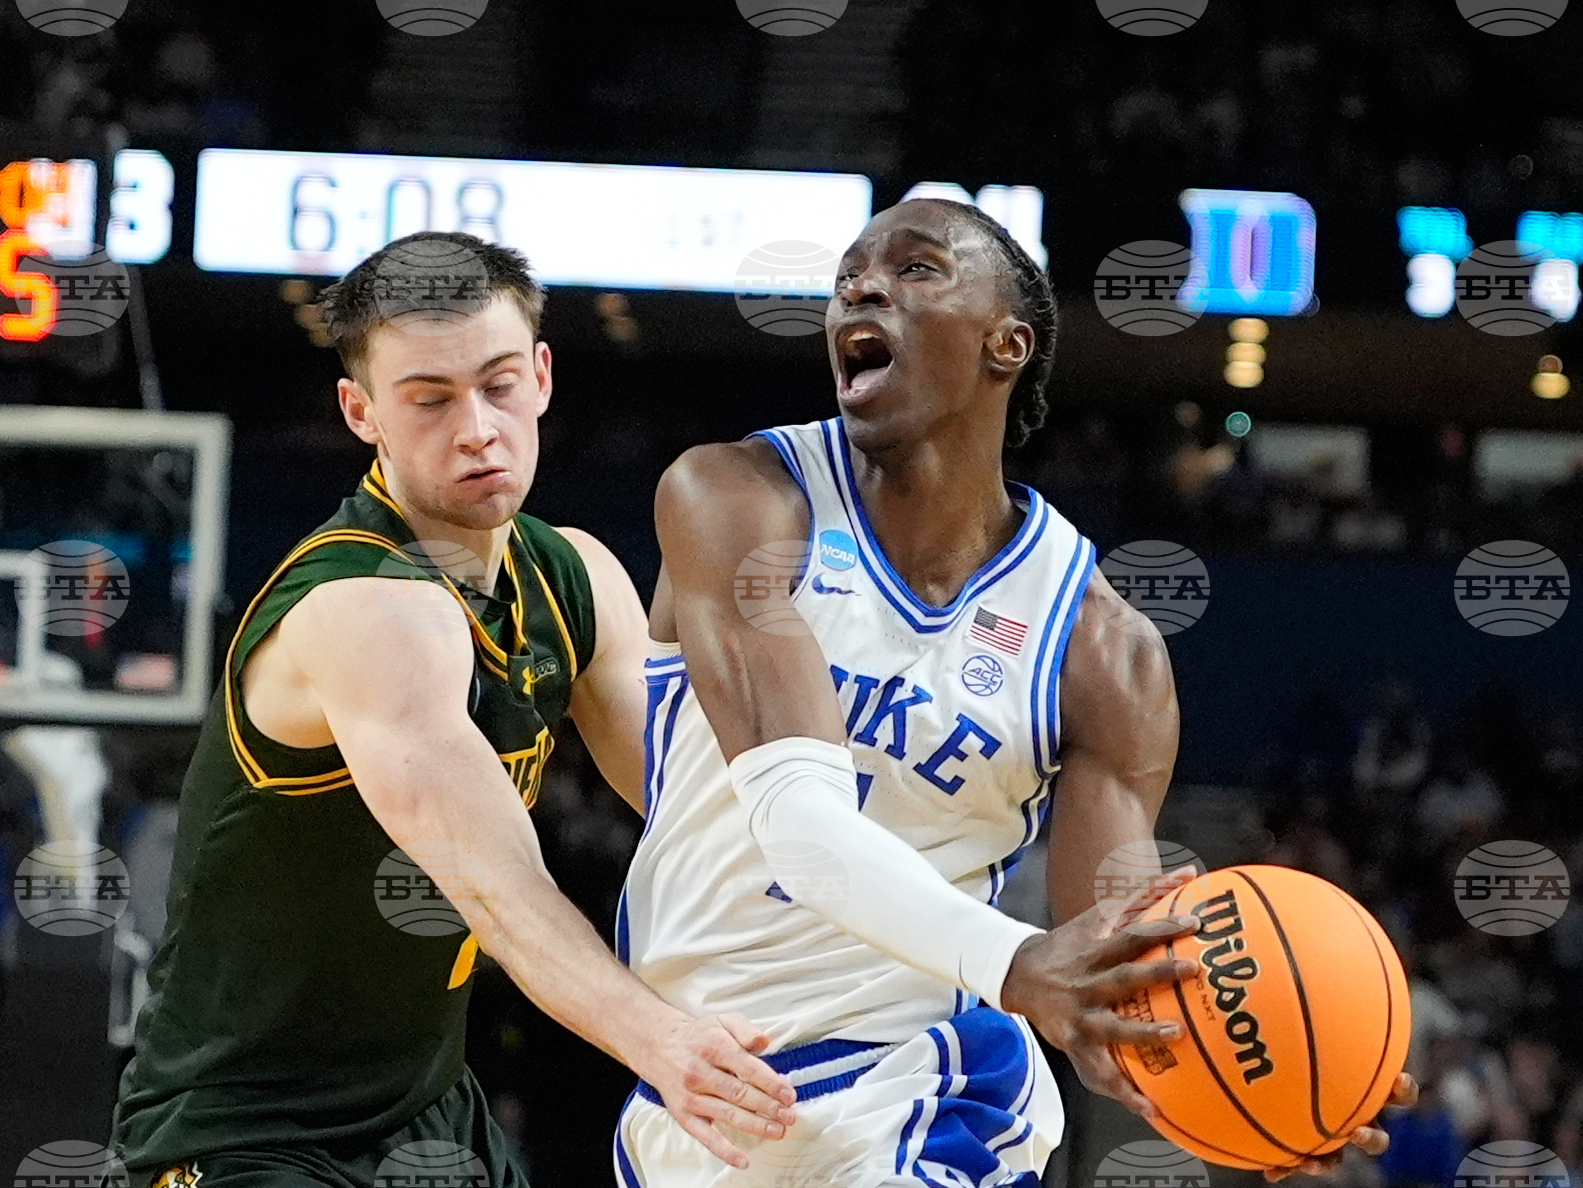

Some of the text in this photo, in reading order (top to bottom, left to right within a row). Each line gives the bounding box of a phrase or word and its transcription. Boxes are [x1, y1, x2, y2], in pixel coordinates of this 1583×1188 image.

[820, 544, 856, 565] NCAA
[968, 666, 1002, 686] ACC
[1191, 888, 1275, 1086] Wilson
